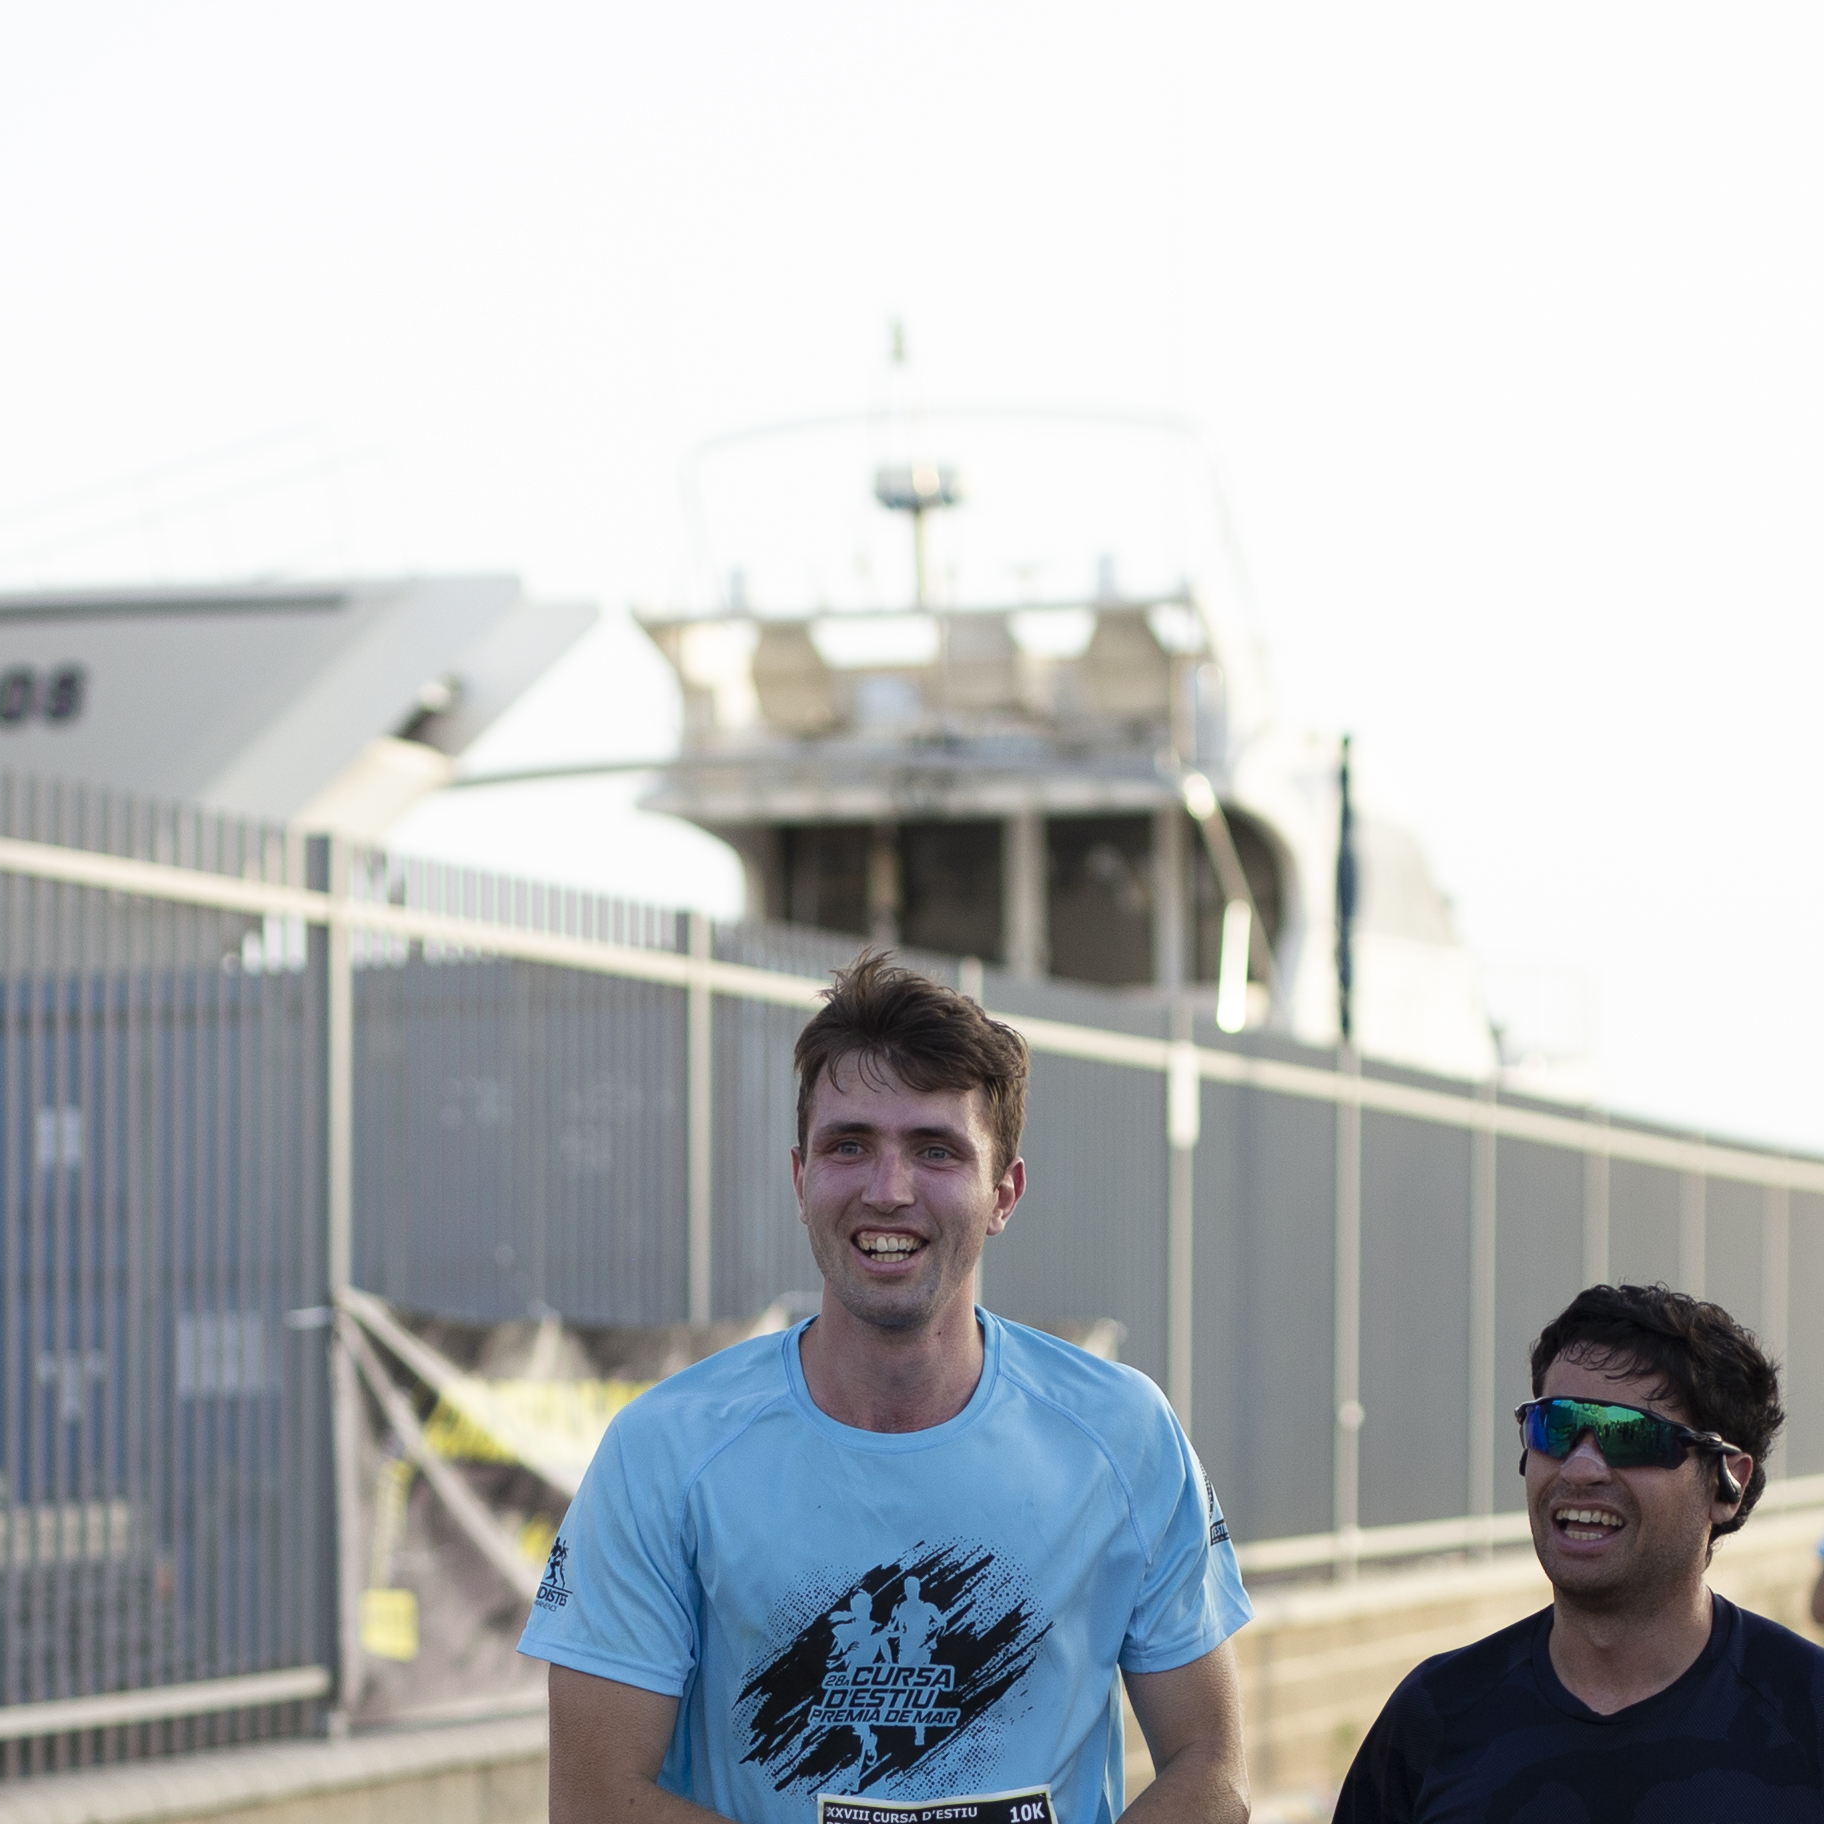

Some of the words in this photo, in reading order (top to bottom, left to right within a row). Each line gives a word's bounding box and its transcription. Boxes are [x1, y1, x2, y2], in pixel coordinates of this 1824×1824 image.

[850, 1666, 952, 1688] CURSA
[824, 1688, 936, 1709] D'ESTIU
[884, 1709, 914, 1723] DE
[912, 1710, 958, 1724] MAR
[826, 1807, 870, 1822] XXVIII
[872, 1811, 918, 1824] CURSA
[922, 1806, 978, 1820] D'ESTIU
[1009, 1801, 1046, 1824] 10K
